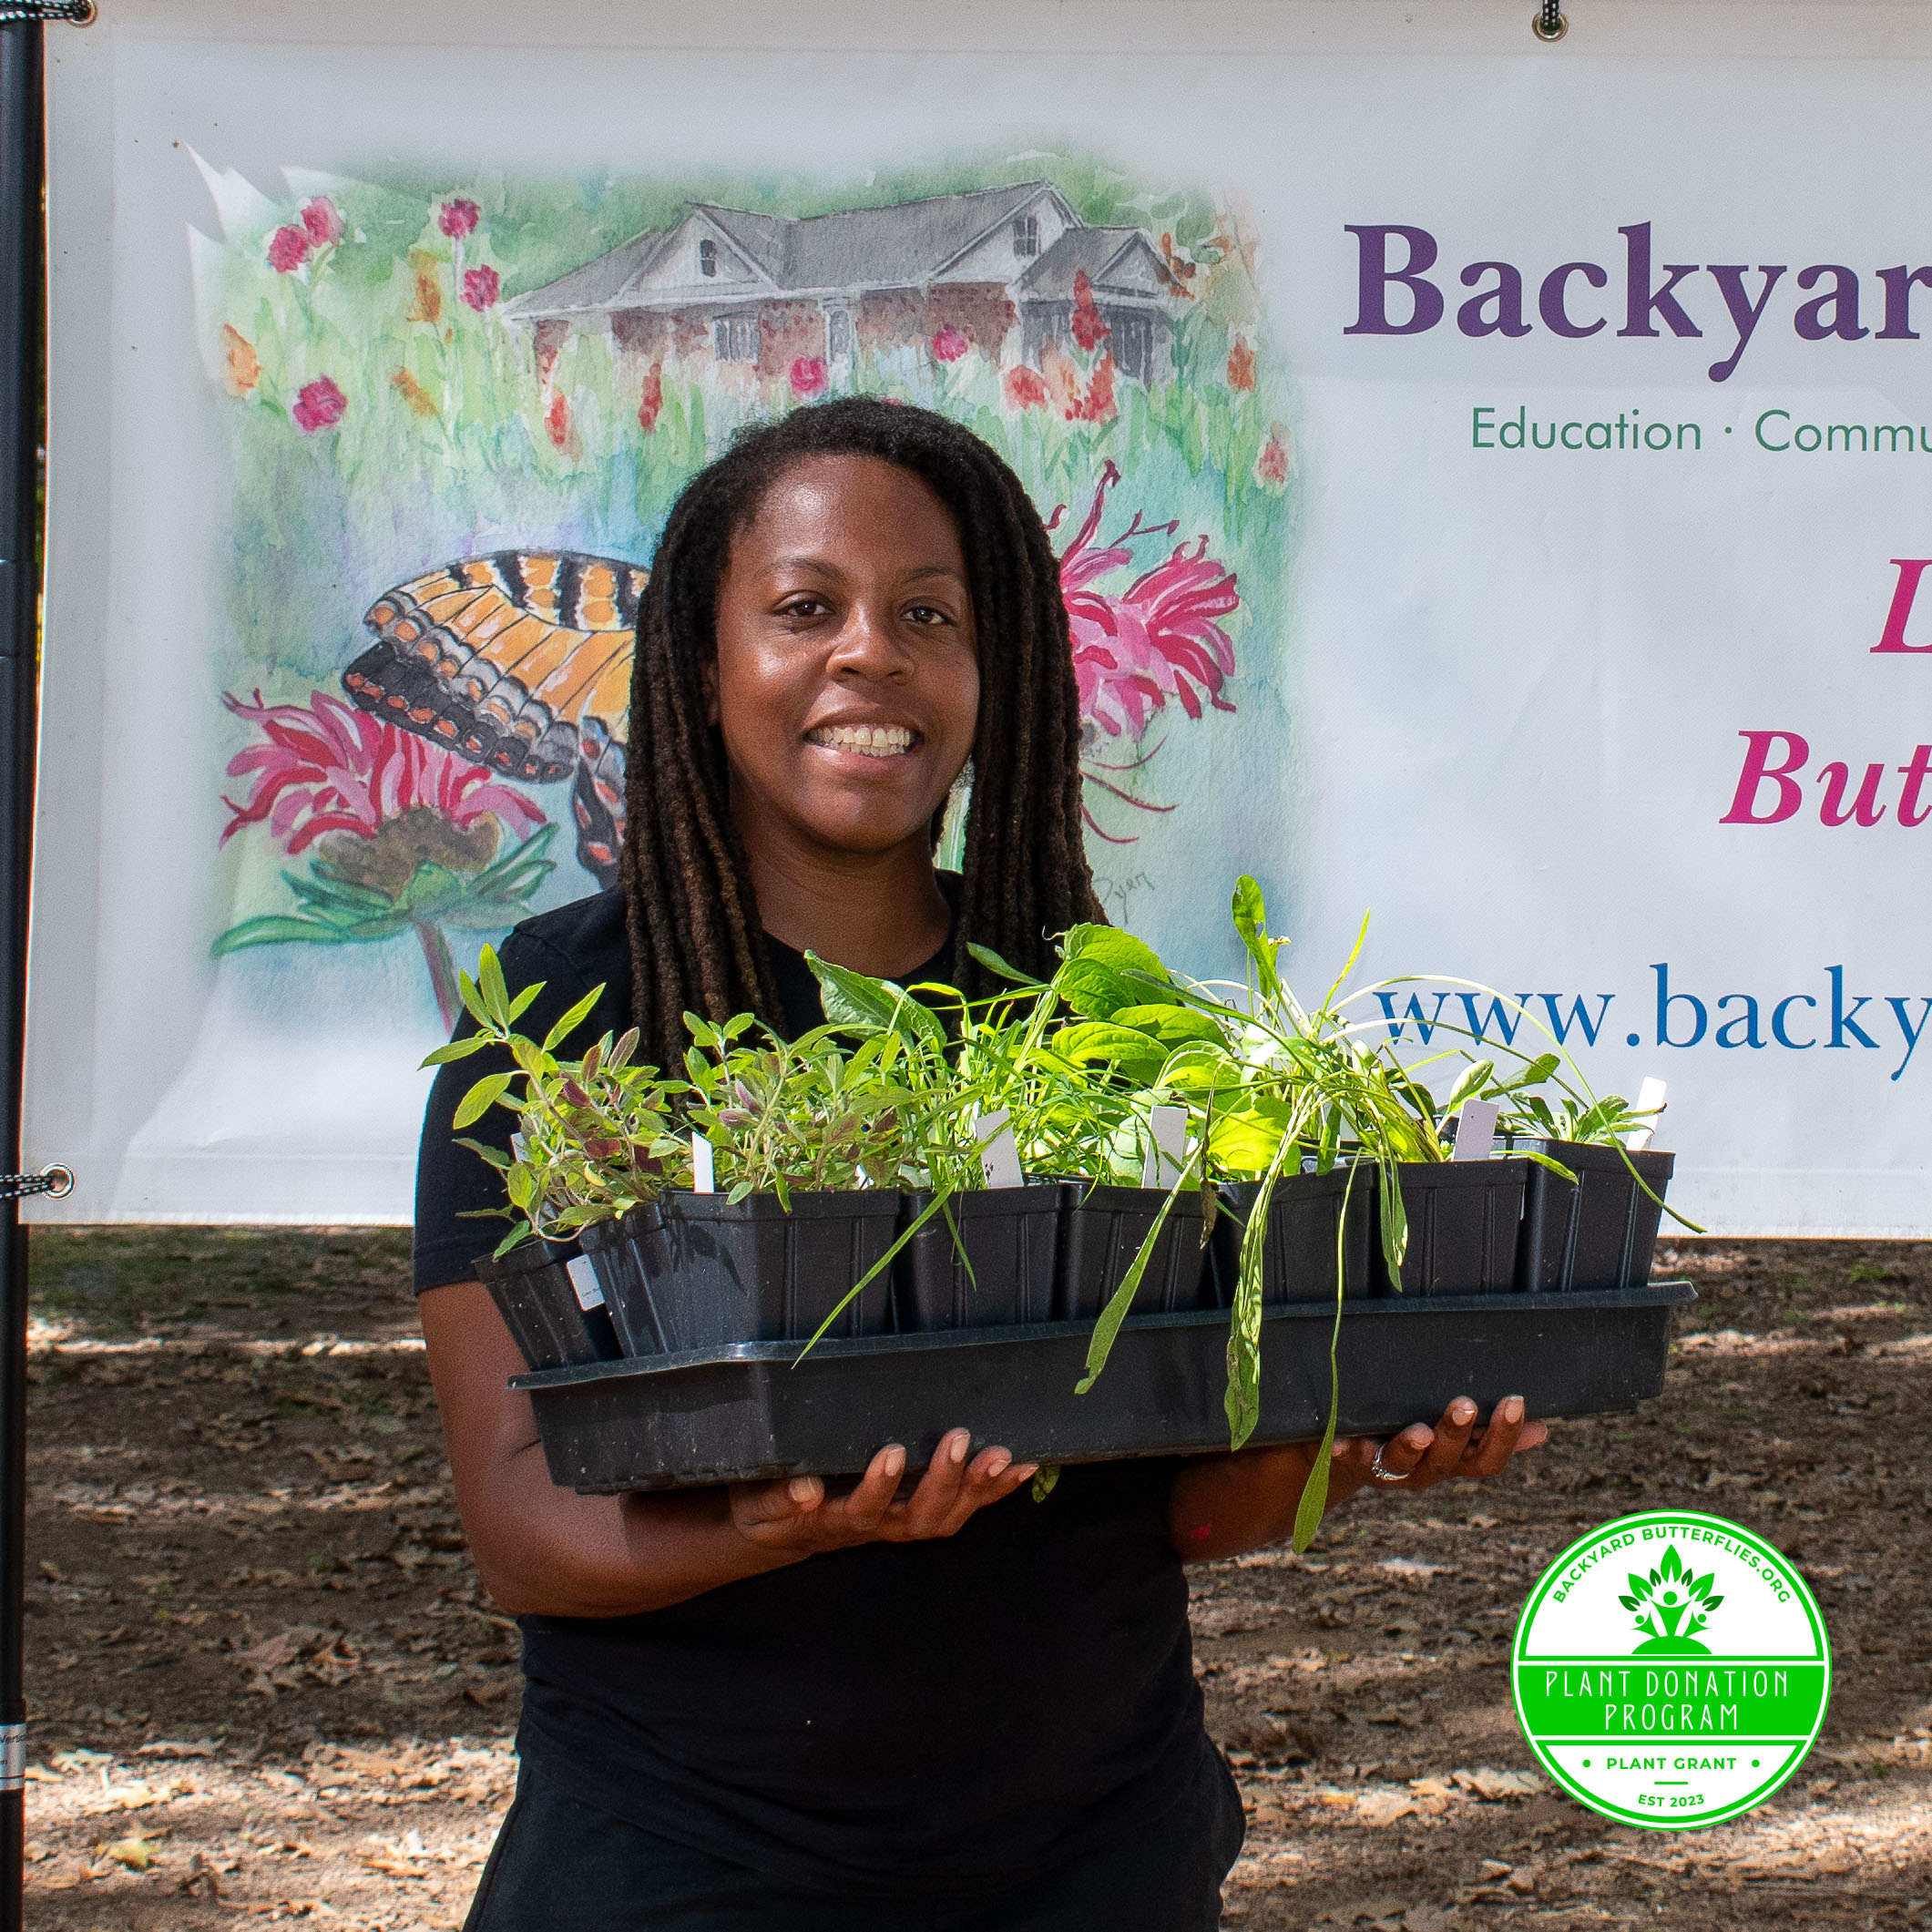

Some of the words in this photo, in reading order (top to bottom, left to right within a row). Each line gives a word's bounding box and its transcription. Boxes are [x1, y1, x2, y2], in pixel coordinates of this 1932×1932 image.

[1343, 220, 1932, 383] Backyar
[1471, 404, 1702, 451] Education
[1719, 730, 1932, 827] But
[1371, 962, 1932, 1082] www.backy
